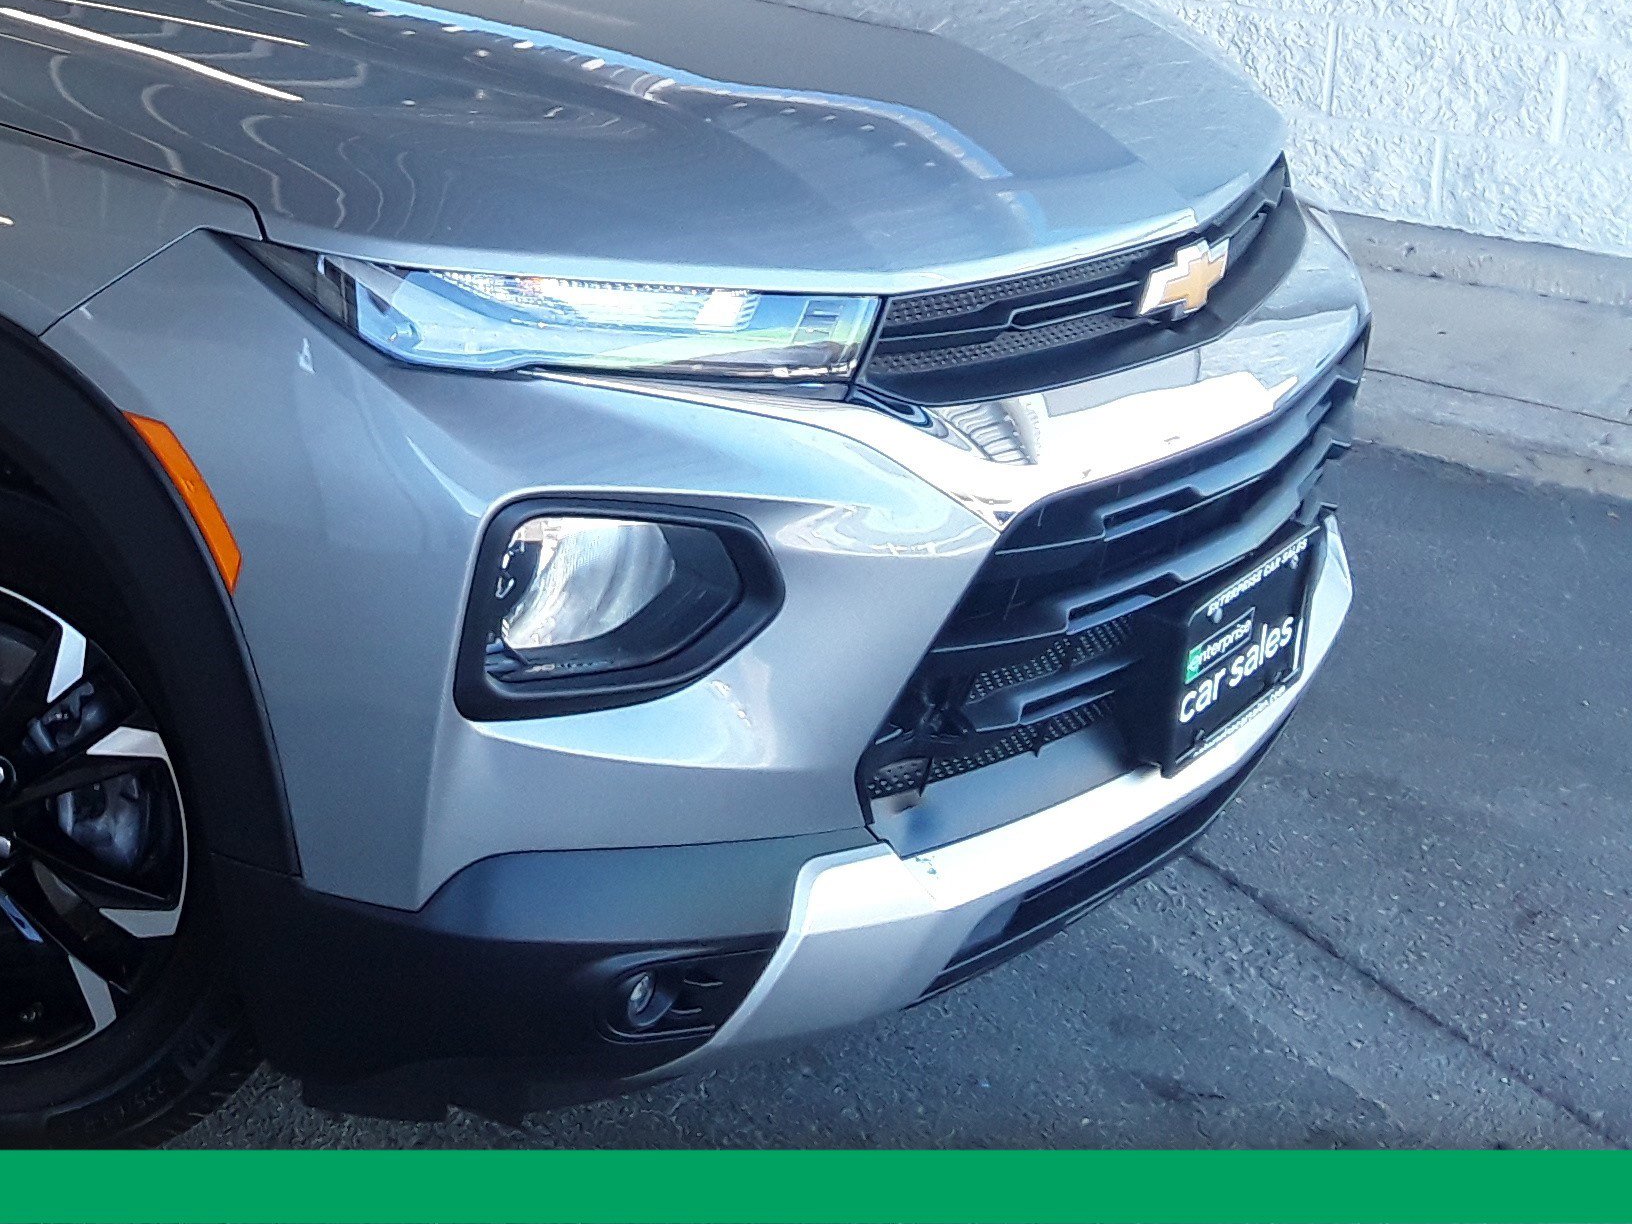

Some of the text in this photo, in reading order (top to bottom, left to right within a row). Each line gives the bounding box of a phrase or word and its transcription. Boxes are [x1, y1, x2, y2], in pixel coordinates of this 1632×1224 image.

[1179, 668, 1226, 723] car
[1228, 616, 1294, 687] sales
[1187, 619, 1252, 672] enterprise
